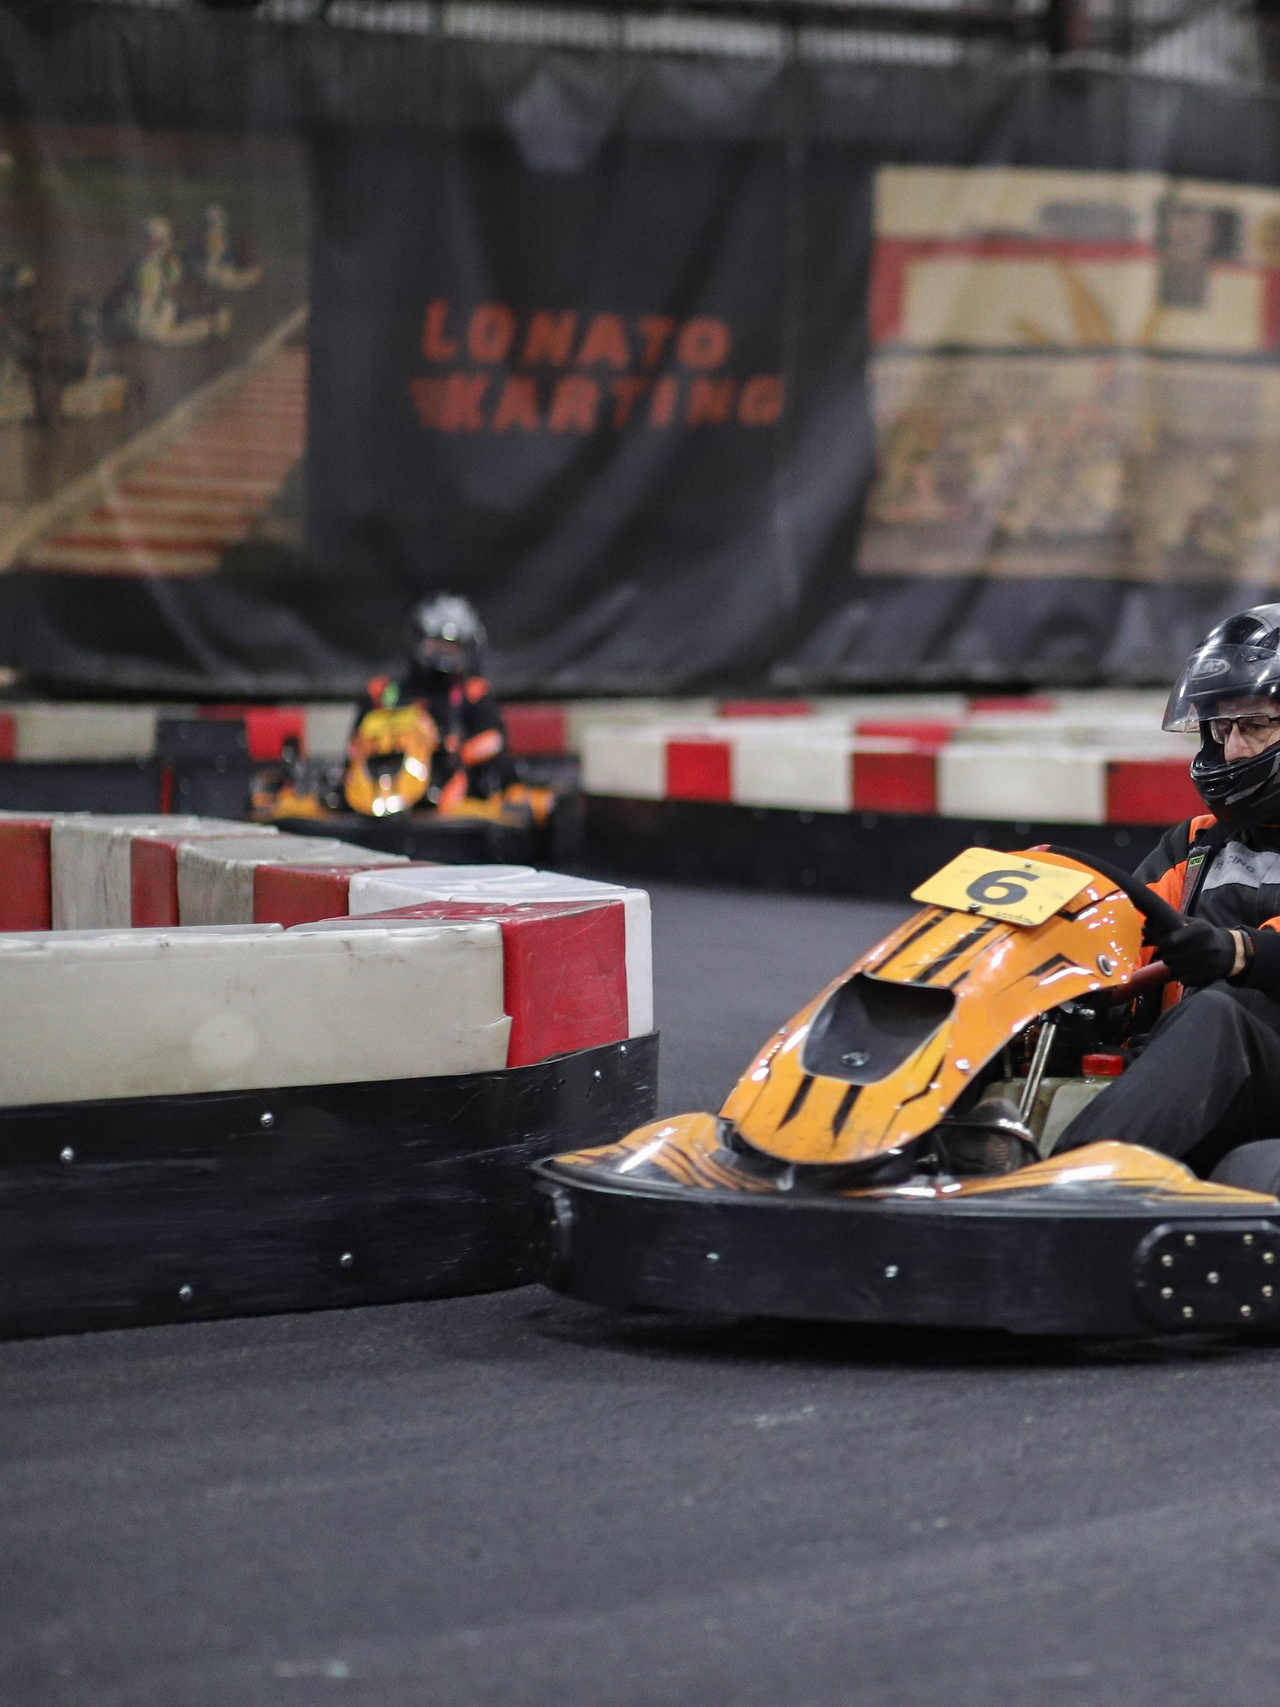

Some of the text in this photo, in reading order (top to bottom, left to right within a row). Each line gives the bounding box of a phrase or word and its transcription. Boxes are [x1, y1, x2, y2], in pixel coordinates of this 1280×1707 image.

[421, 299, 732, 370] LONATO
[410, 373, 786, 433] KARTING
[966, 870, 1040, 905] 6
